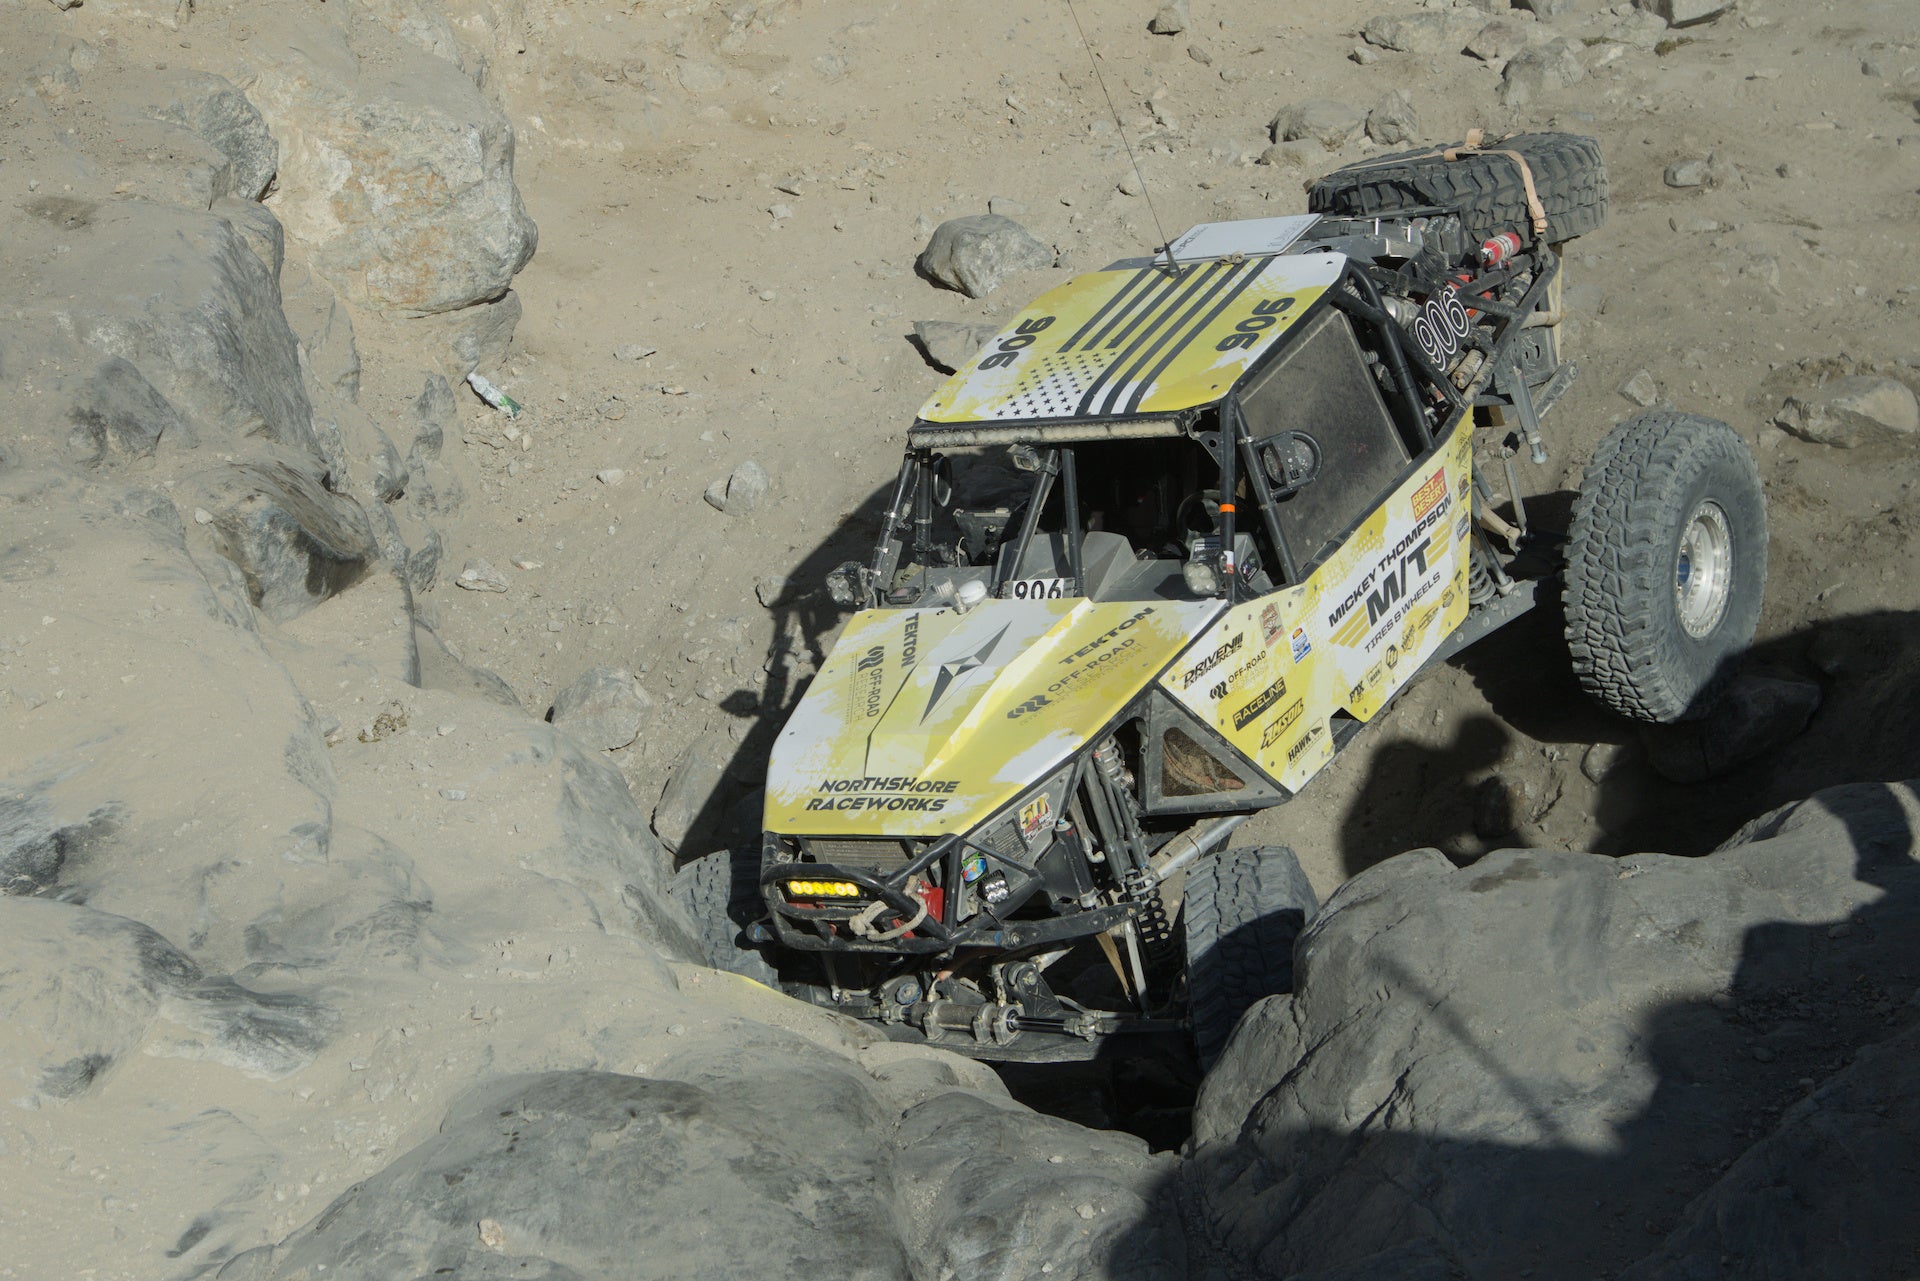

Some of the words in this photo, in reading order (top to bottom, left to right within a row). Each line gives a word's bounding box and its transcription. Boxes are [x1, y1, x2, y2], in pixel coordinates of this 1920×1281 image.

[978, 315, 1056, 371] 906
[1215, 297, 1296, 352] 906
[1415, 285, 1469, 371] 906
[1413, 479, 1435, 505] BEST
[1414, 481, 1445, 517] DESERT
[1328, 568, 1376, 627] MICKEY
[1377, 493, 1452, 571] THOMPSON
[1366, 537, 1431, 627] M/T
[1015, 579, 1061, 599] 906
[1364, 619, 1394, 653] TIRES
[1394, 611, 1402, 623] &
[1402, 572, 1440, 613] WHEELS
[901, 612, 919, 667] TEKTON
[1058, 607, 1156, 664] TEKTON
[1048, 639, 1135, 692] OFF-ROAD
[1184, 637, 1239, 684] DRIVEN
[1228, 650, 1266, 683] OFF-ROAD
[867, 668, 883, 717] OFF-ROAD
[1233, 677, 1285, 725] RACELINE
[1288, 732, 1311, 761] HAWK
[806, 797, 951, 811] RACEWORKS
[819, 777, 960, 793] NORTHSHORE
